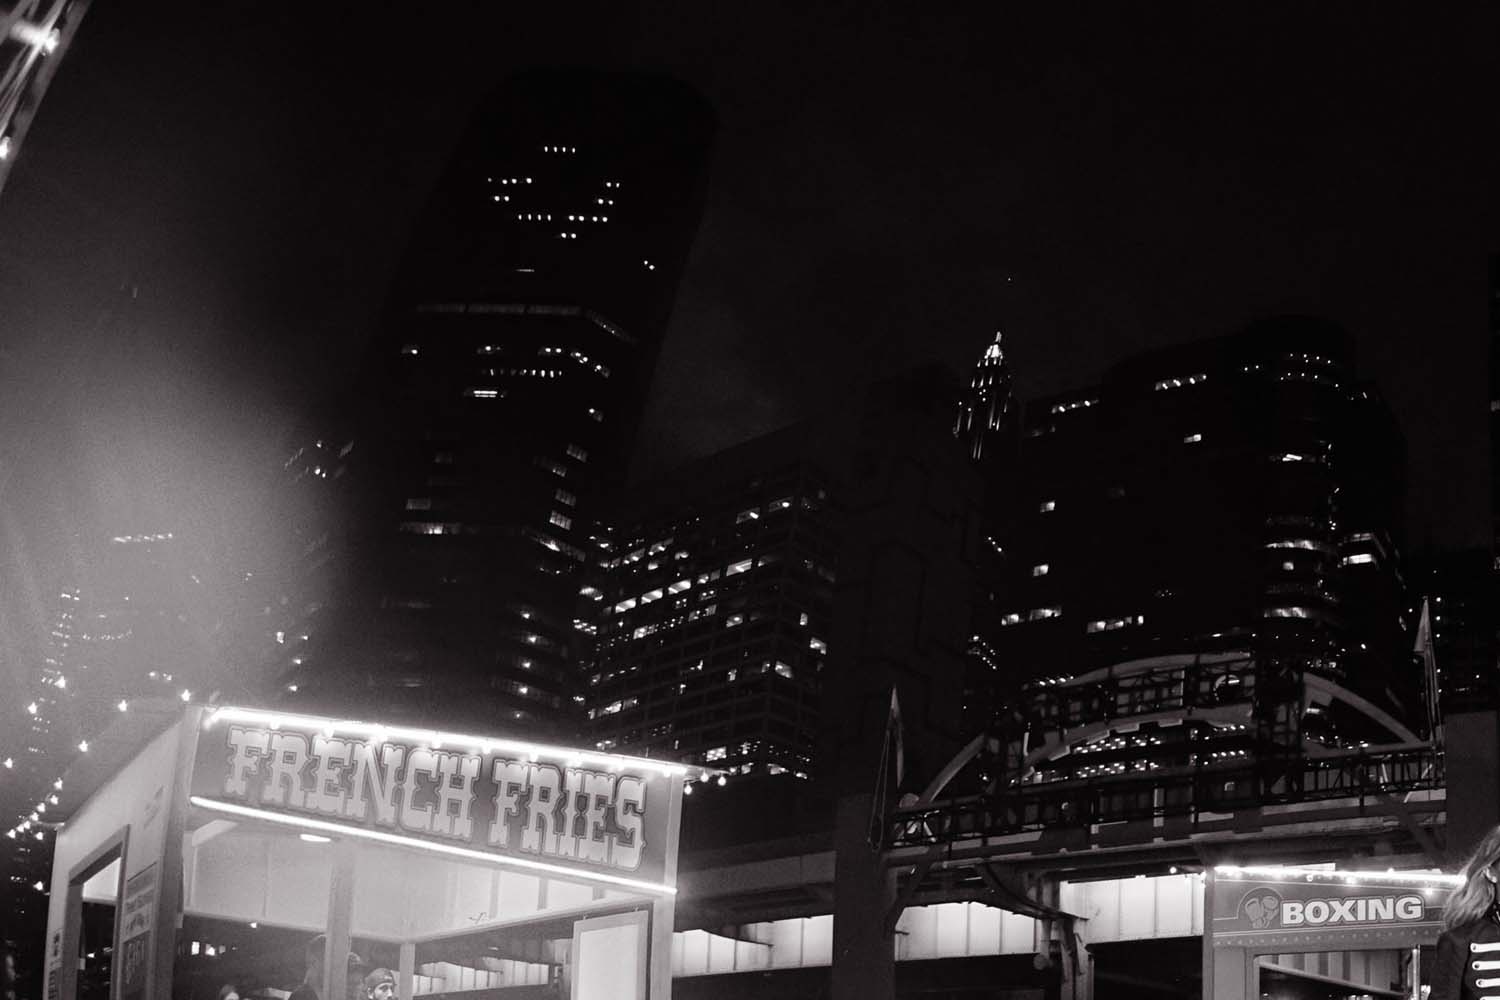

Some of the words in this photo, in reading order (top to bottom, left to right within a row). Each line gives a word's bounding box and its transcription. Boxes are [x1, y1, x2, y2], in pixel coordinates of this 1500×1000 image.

[226, 726, 481, 840] FRENCH
[487, 757, 648, 872] FRIES
[1281, 896, 1423, 926] BOXING
